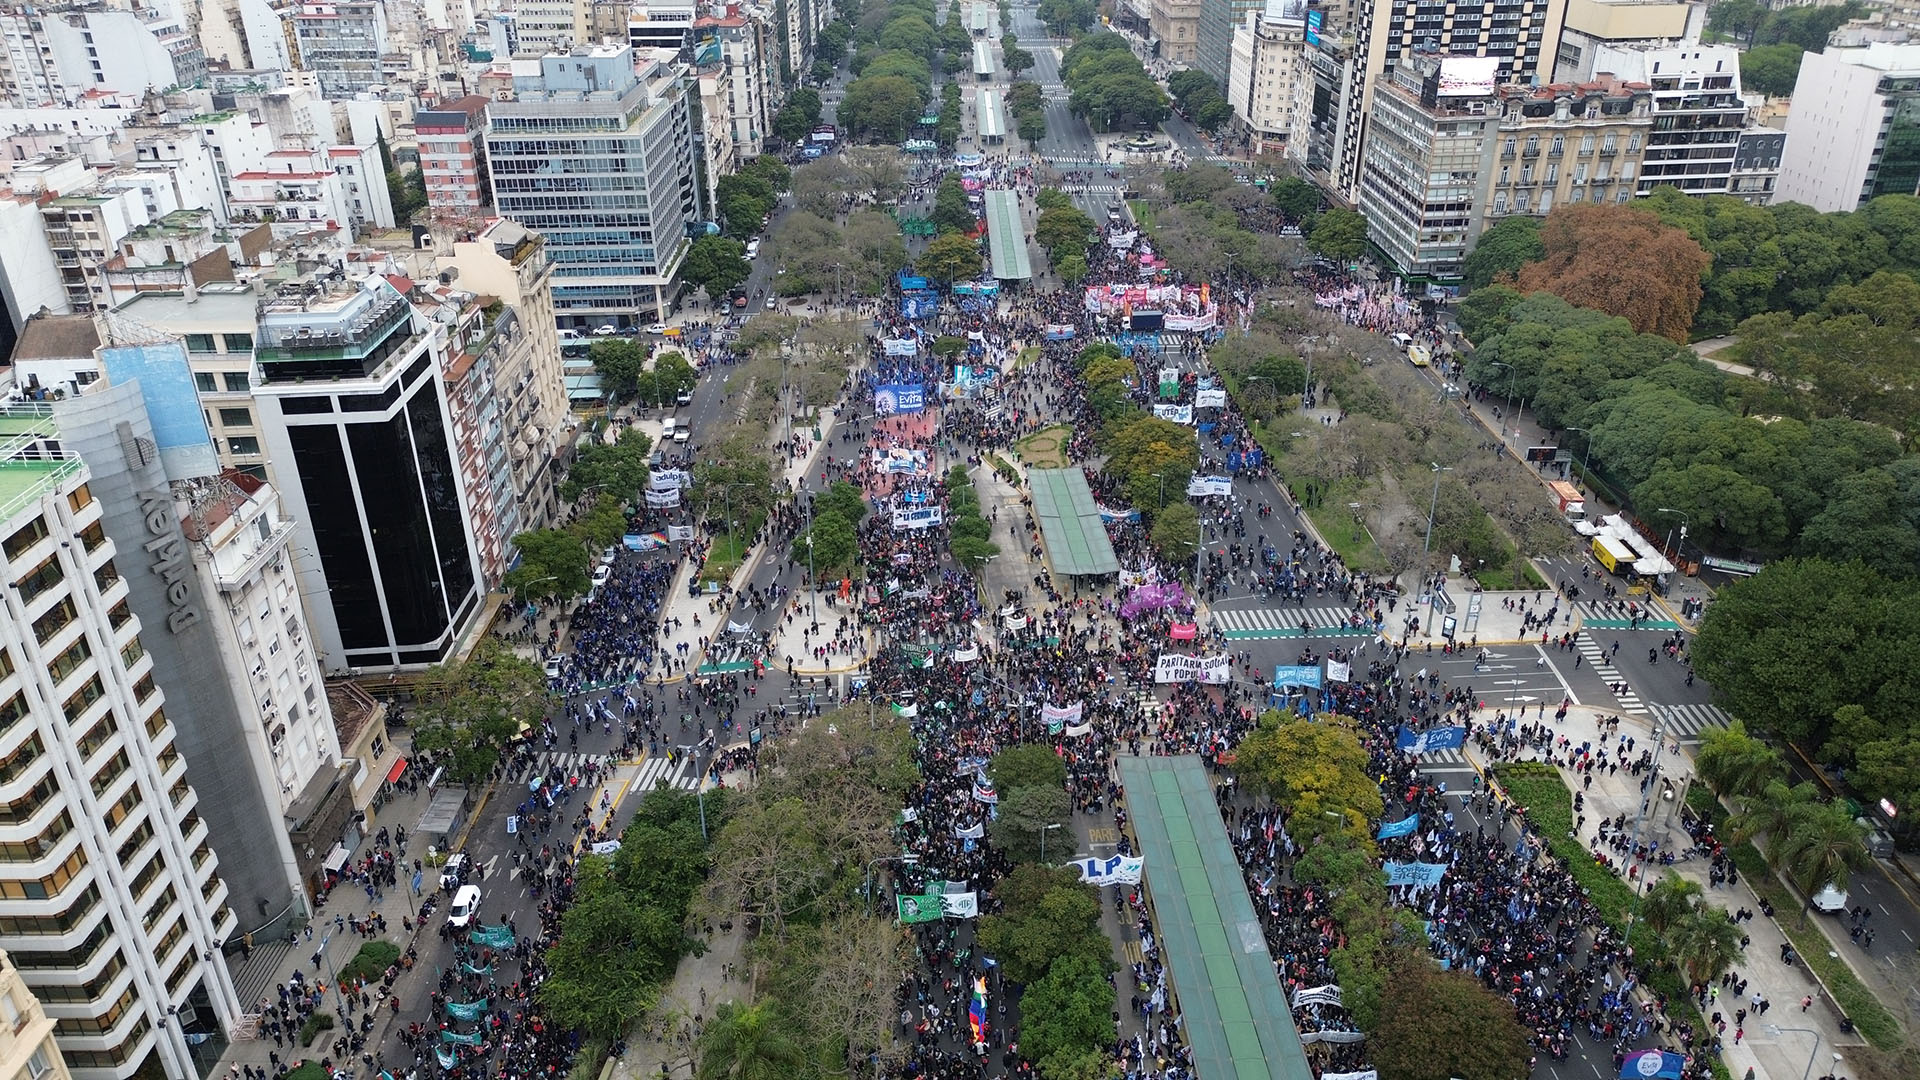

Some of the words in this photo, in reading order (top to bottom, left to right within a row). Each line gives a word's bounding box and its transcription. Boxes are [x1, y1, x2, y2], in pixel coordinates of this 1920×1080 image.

[906, 138, 937, 149] SMATA
[137, 490, 201, 635] Berkley
[1160, 655, 1202, 669] PARITARIA
[1204, 654, 1229, 670] SOCIAL
[1165, 670, 1171, 679] Y
[1174, 668, 1211, 680] POPUR
[1089, 828, 1116, 842] PARE
